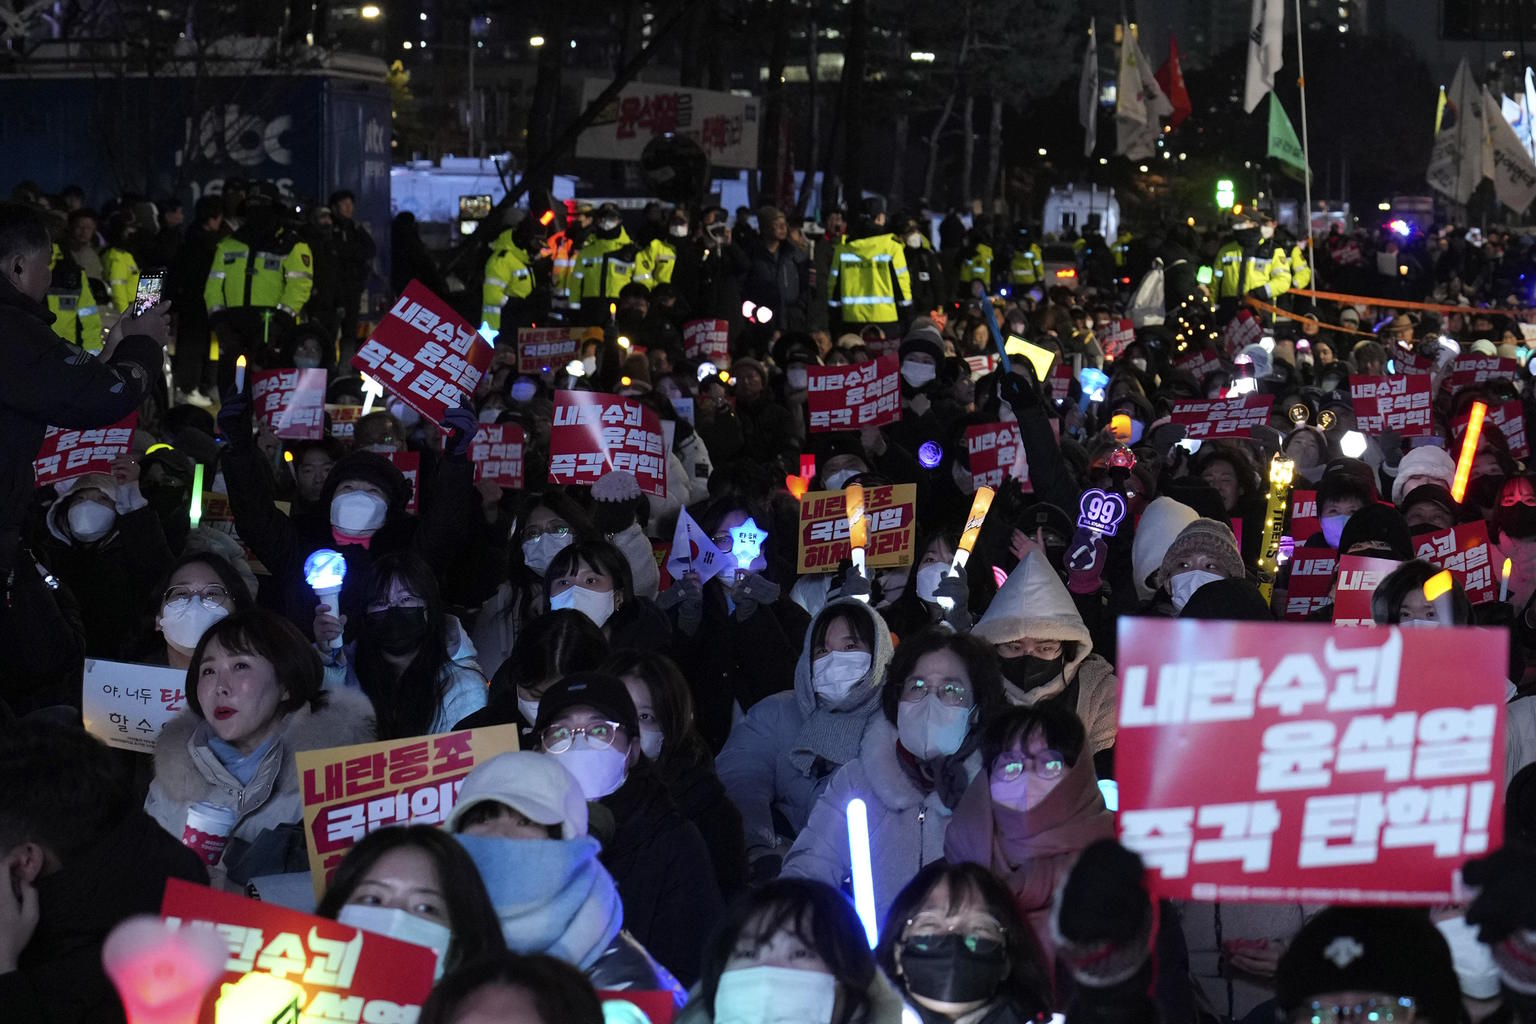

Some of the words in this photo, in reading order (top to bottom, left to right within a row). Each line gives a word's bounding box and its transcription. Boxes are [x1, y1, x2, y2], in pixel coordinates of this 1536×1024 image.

[391, 296, 477, 356] 내란수괴
[359, 341, 415, 382] 즉각
[407, 367, 463, 409] 탄핵
[414, 342, 483, 393] 윤석열
[808, 360, 878, 393] 내란수괴
[1452, 358, 1499, 373] 내란수괴
[846, 371, 899, 406] 윤석열
[1351, 375, 1407, 400] 내란수괴
[552, 401, 643, 427] 내란수괴
[810, 408, 852, 427] 즉각
[857, 390, 899, 425] 탄핵!
[1175, 397, 1247, 414] 내란수괴
[1206, 408, 1271, 423] 윤석열
[1377, 391, 1430, 415] 윤석열
[1215, 417, 1268, 433] 탄핵!
[1357, 416, 1384, 432] 즉각
[1387, 407, 1430, 431] 탄핵!
[56, 428, 132, 453] 윤석열
[474, 427, 503, 444] 수괴
[600, 426, 663, 455] 윤석열
[37, 454, 62, 476] 각
[550, 452, 607, 478] 즉각
[611, 452, 665, 479] 탄핵!
[1087, 497, 1116, 524] 99
[738, 531, 758, 545] 탄핵
[811, 507, 904, 545] 국민힘
[1265, 509, 1282, 560] TIGERS
[804, 531, 911, 570] 해체라!
[1414, 528, 1458, 561] 수괴
[1443, 542, 1489, 575] 석열
[1465, 564, 1493, 593] 핵!
[1120, 628, 1401, 729] 내란수괴
[102, 684, 122, 700] 야,
[126, 687, 153, 705] 너두
[160, 688, 187, 713] 탄
[109, 712, 129, 733] 할
[136, 718, 155, 734] 수
[1258, 703, 1498, 794] 윤석열
[303, 731, 474, 808] 내란동조
[326, 782, 456, 843] 국민의
[1120, 799, 1281, 878] 즉각
[1298, 780, 1495, 869] 탄핵!
